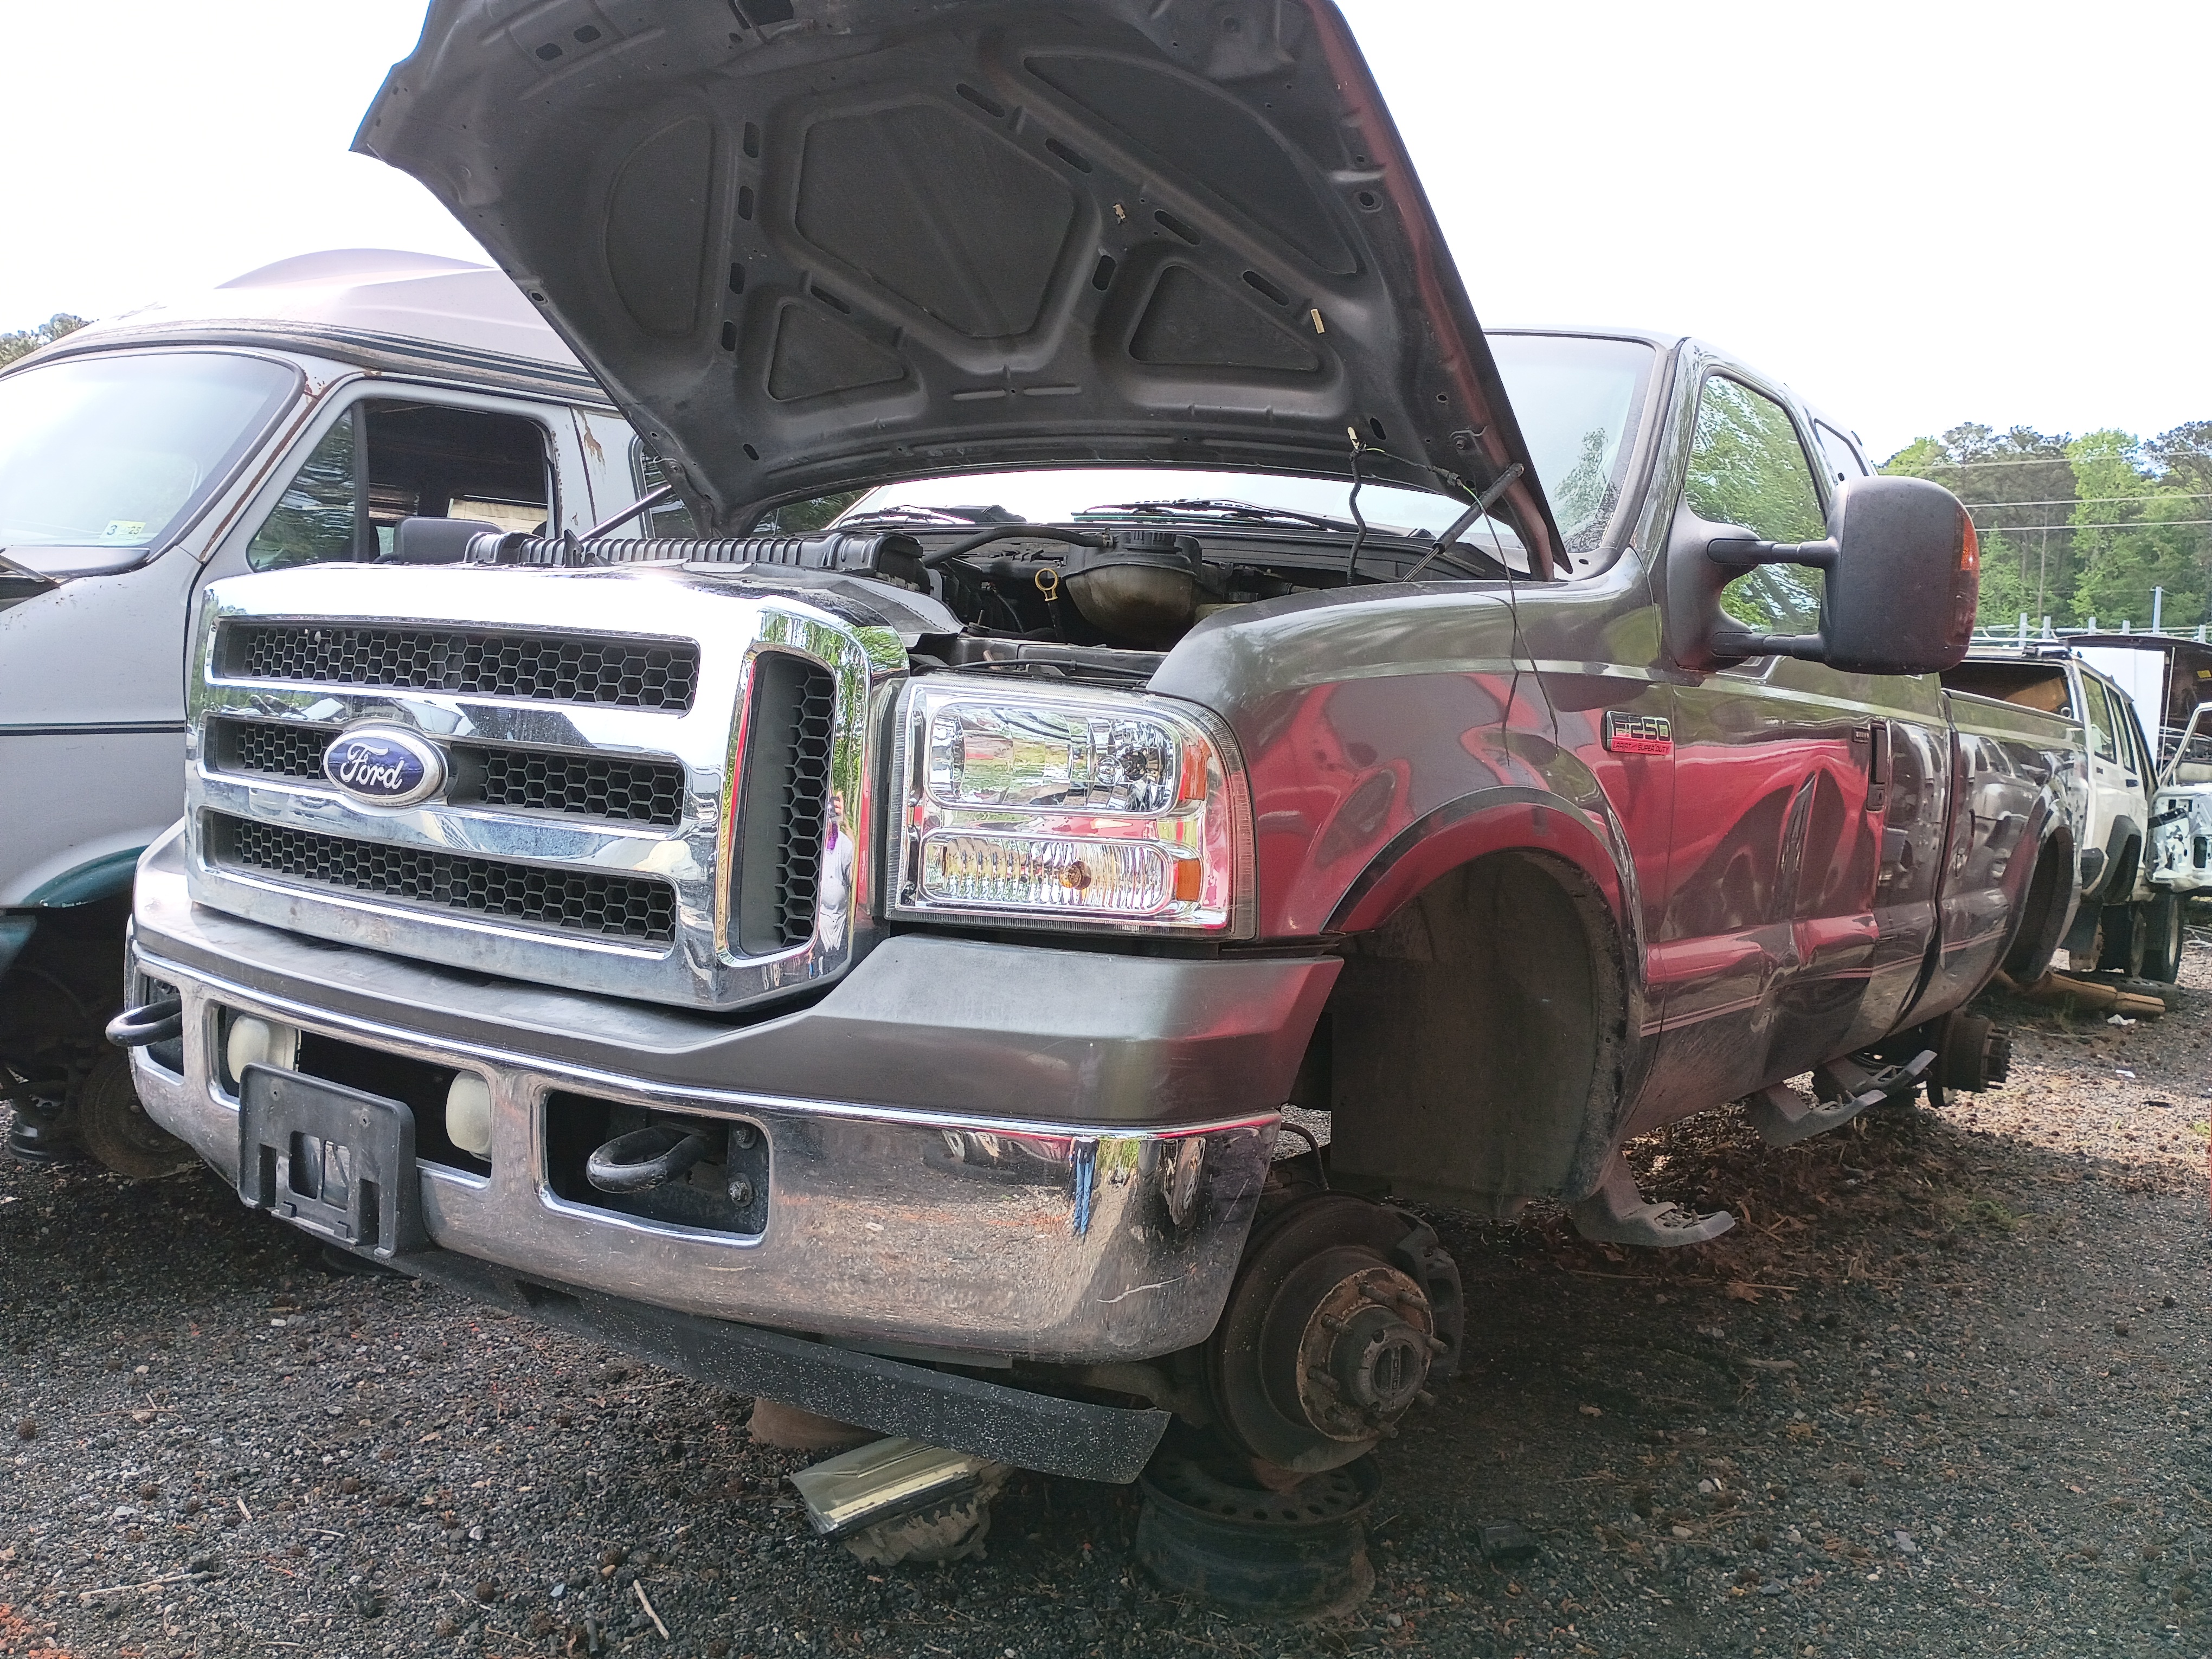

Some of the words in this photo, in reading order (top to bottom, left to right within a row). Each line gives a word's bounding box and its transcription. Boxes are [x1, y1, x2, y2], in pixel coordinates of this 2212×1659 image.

[106, 524, 118, 536] 3
[1613, 742, 1631, 750] LARIAT
[1637, 743, 1655, 752] SUPER
[1655, 744, 1669, 753] DUTY
[340, 742, 404, 789] Ford
